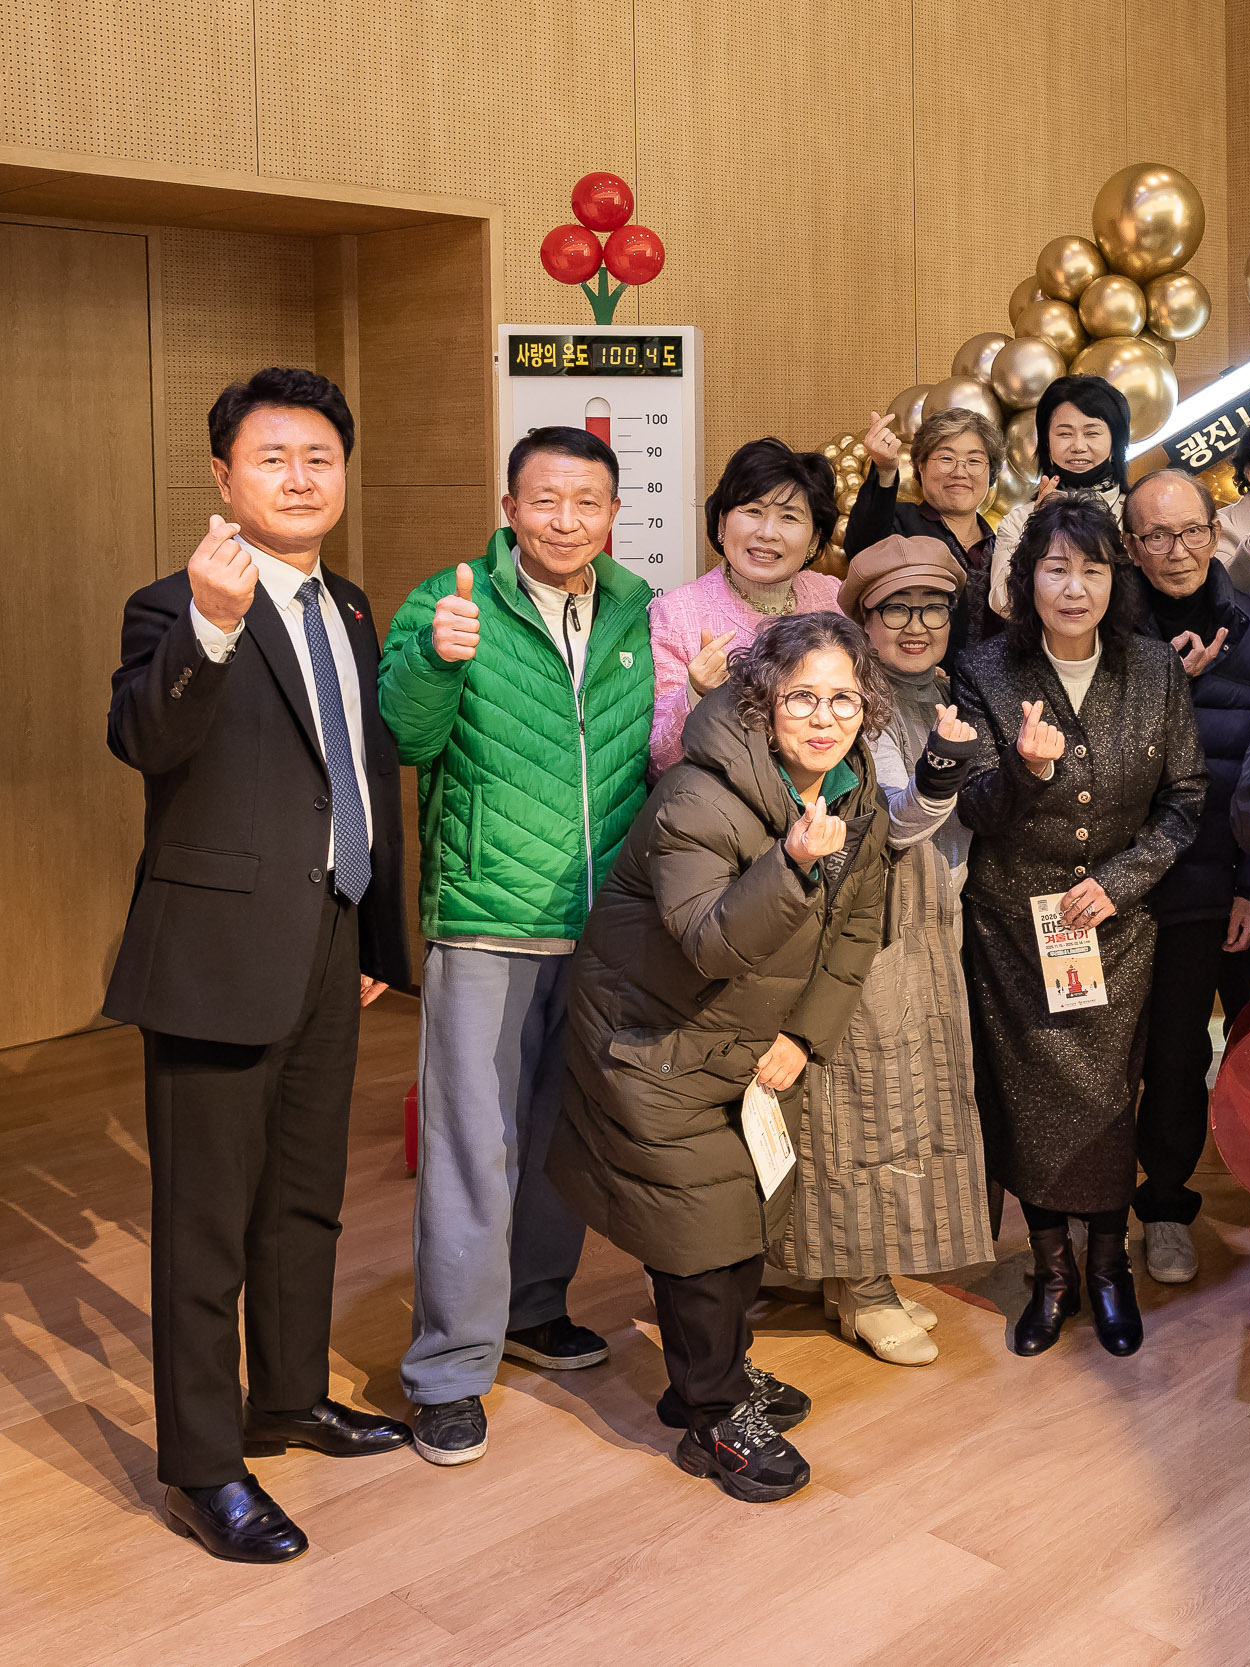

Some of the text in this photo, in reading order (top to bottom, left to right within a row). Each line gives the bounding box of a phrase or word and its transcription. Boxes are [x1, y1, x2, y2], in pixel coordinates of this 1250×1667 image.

[516, 342, 557, 368] 사랑의
[562, 342, 589, 368] 온도
[645, 413, 668, 425] 100
[1175, 414, 1241, 468] 광진
[646, 446, 662, 458] 90
[647, 482, 663, 493] 80
[648, 518, 663, 529] 70
[648, 553, 664, 564] 60
[1041, 913, 1057, 921] 2026
